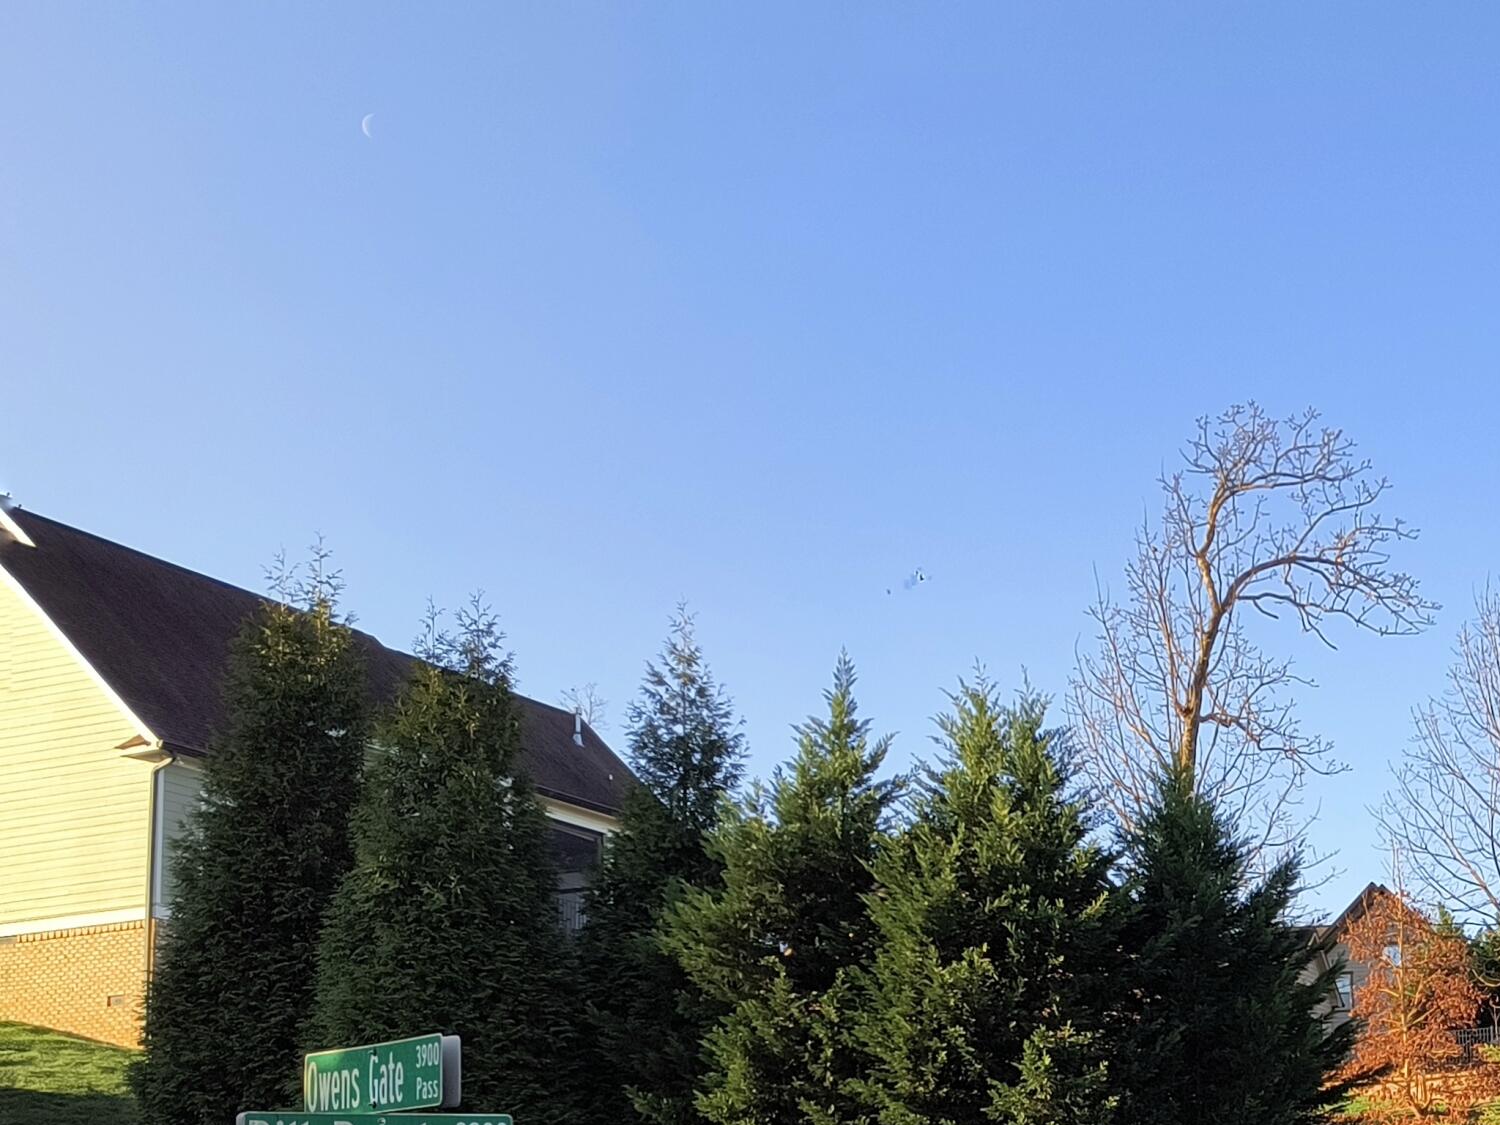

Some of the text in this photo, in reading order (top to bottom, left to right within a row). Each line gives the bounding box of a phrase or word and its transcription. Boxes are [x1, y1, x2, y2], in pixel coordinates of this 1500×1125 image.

[415, 1041, 440, 1069] 3900
[307, 1051, 404, 1113] Owens Gate
[415, 1077, 438, 1100] Pass
